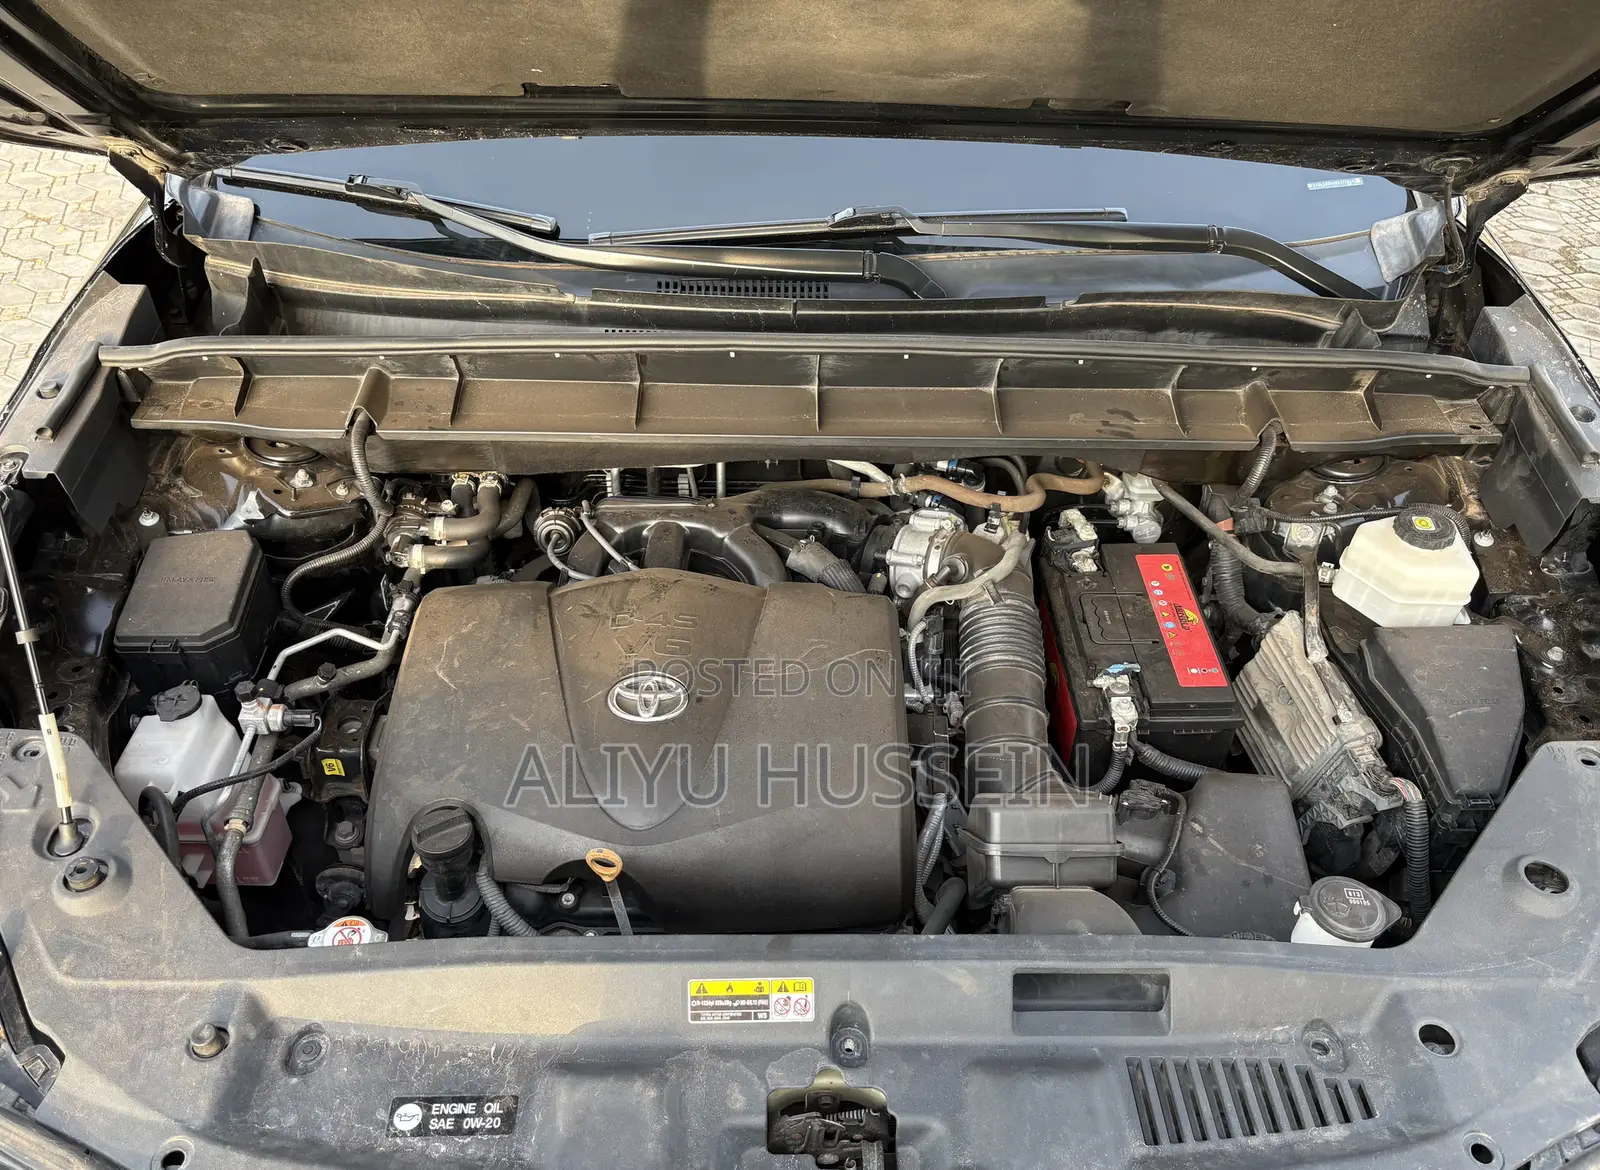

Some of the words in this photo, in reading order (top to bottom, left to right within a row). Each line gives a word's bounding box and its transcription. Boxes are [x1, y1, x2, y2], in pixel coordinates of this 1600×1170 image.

[613, 634, 692, 657] V6
[431, 1103, 477, 1115] ENGINE
[483, 1102, 504, 1114] OIL
[428, 1118, 455, 1130] SAE
[462, 1117, 501, 1129] 0W-20
